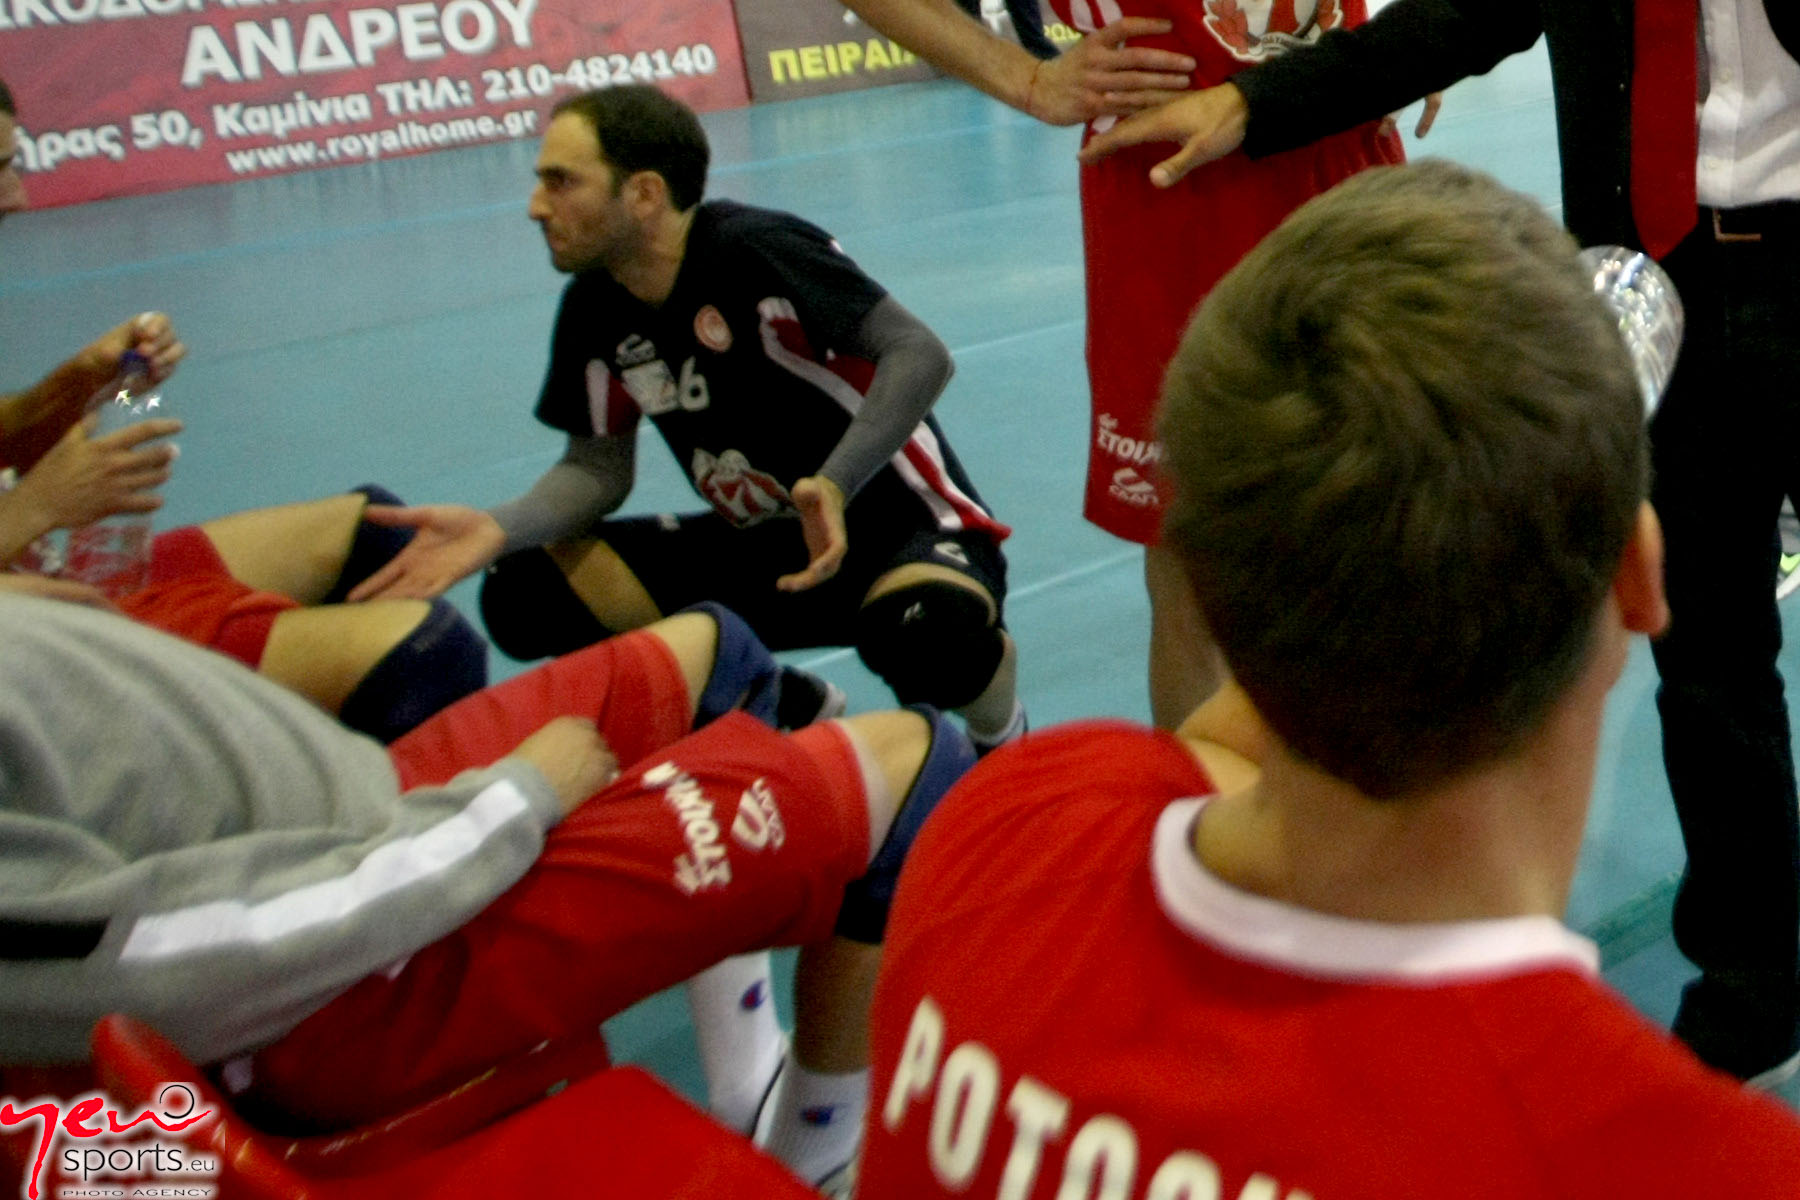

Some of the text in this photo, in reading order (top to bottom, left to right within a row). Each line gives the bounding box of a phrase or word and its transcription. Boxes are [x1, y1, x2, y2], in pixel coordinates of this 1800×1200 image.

[130, 109, 204, 151] 50,
[212, 90, 373, 139] Καμίνια
[376, 75, 474, 116] ΤΗΛ:
[480, 43, 717, 101] 210-4824140
[225, 109, 539, 174] www.royalhome.gr
[884, 994, 1315, 1200] POTO
